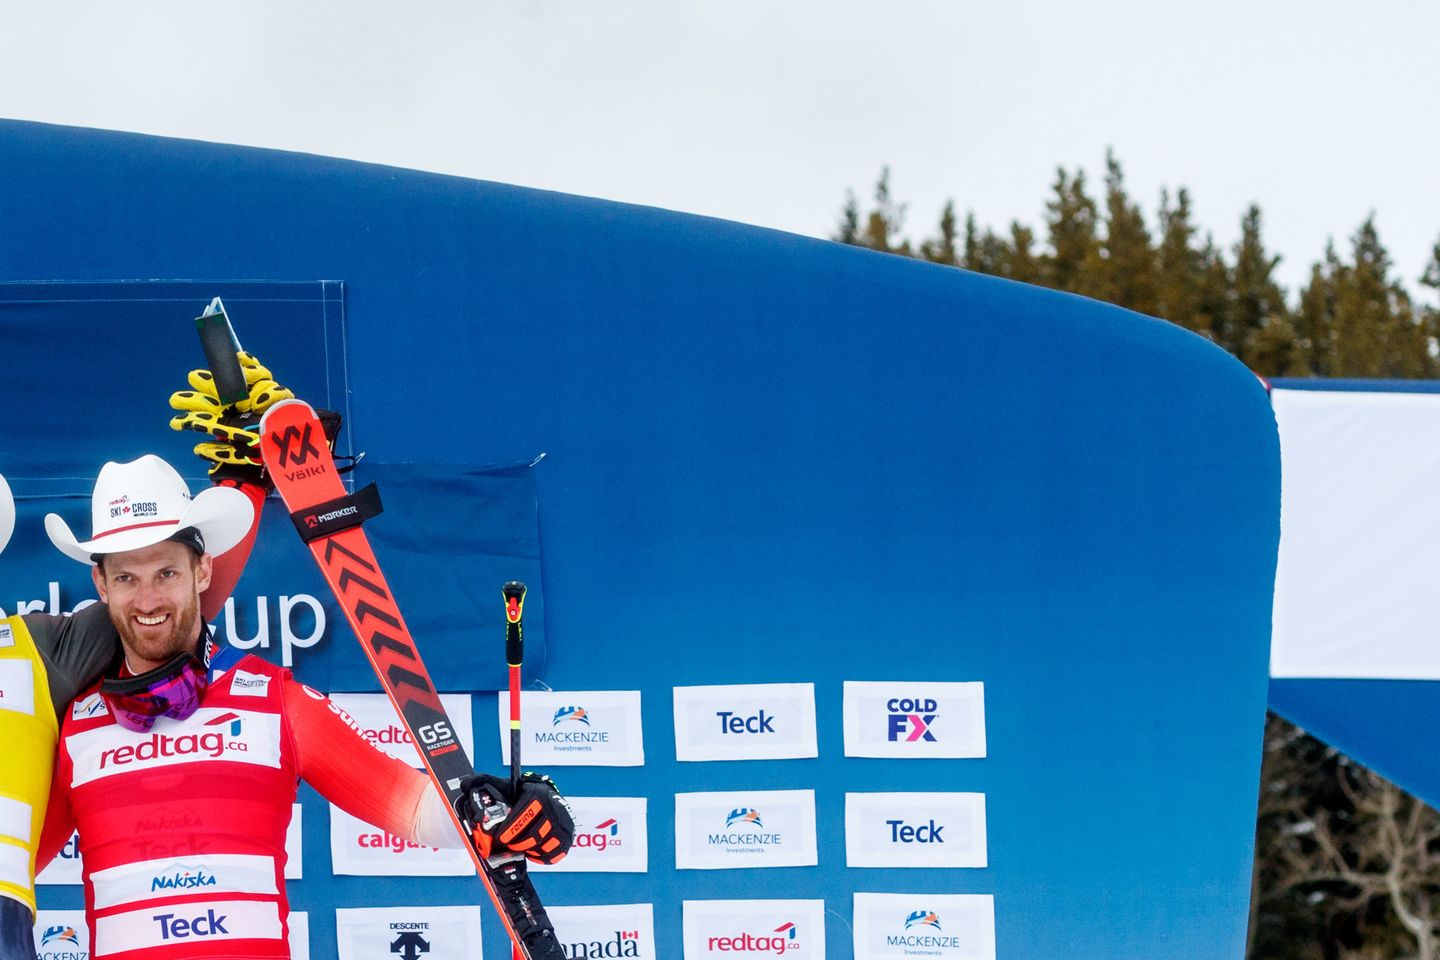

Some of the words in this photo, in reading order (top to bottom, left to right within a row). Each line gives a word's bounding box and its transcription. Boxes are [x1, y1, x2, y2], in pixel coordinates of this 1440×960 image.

[110, 507, 122, 518] SKI
[132, 502, 158, 513] CROSS
[224, 590, 327, 667] up
[887, 698, 937, 712] COLD
[419, 721, 452, 744] GS
[717, 710, 775, 734] Teck
[888, 714, 939, 742] FX
[536, 732, 608, 742] MACKENZIE
[100, 730, 248, 769] redtag.ca
[510, 807, 535, 835] racing
[886, 820, 944, 843] Teck
[709, 834, 781, 844] MACKENZIE
[153, 909, 229, 940] Teck
[709, 932, 799, 955] redtag.ca
[887, 936, 959, 947] MACKENZIE
